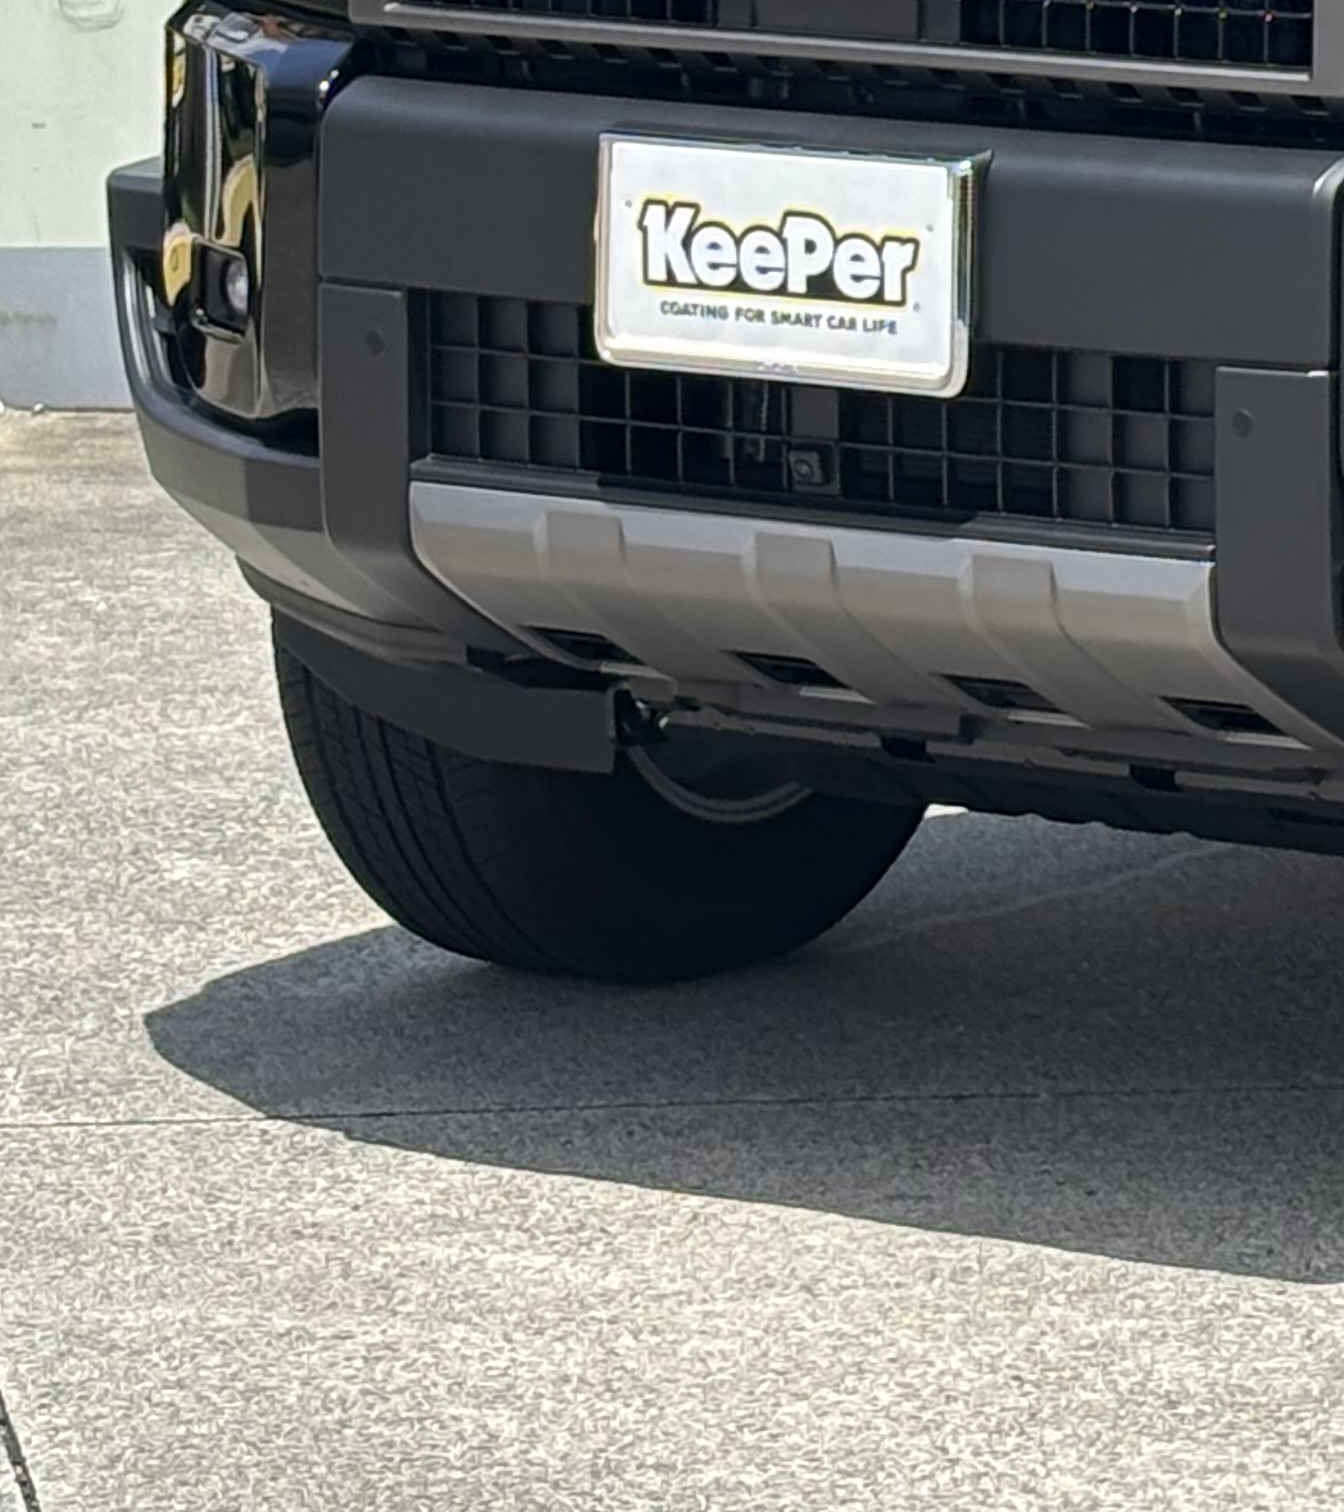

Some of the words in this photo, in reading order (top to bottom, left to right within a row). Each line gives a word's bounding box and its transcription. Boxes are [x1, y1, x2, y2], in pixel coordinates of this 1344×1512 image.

[637, 198, 920, 307] KeePer
[660, 300, 729, 321] COATING
[734, 307, 765, 325] FOR
[770, 310, 822, 329] SMART
[826, 314, 857, 331] CAR
[862, 317, 898, 335] LIFE
